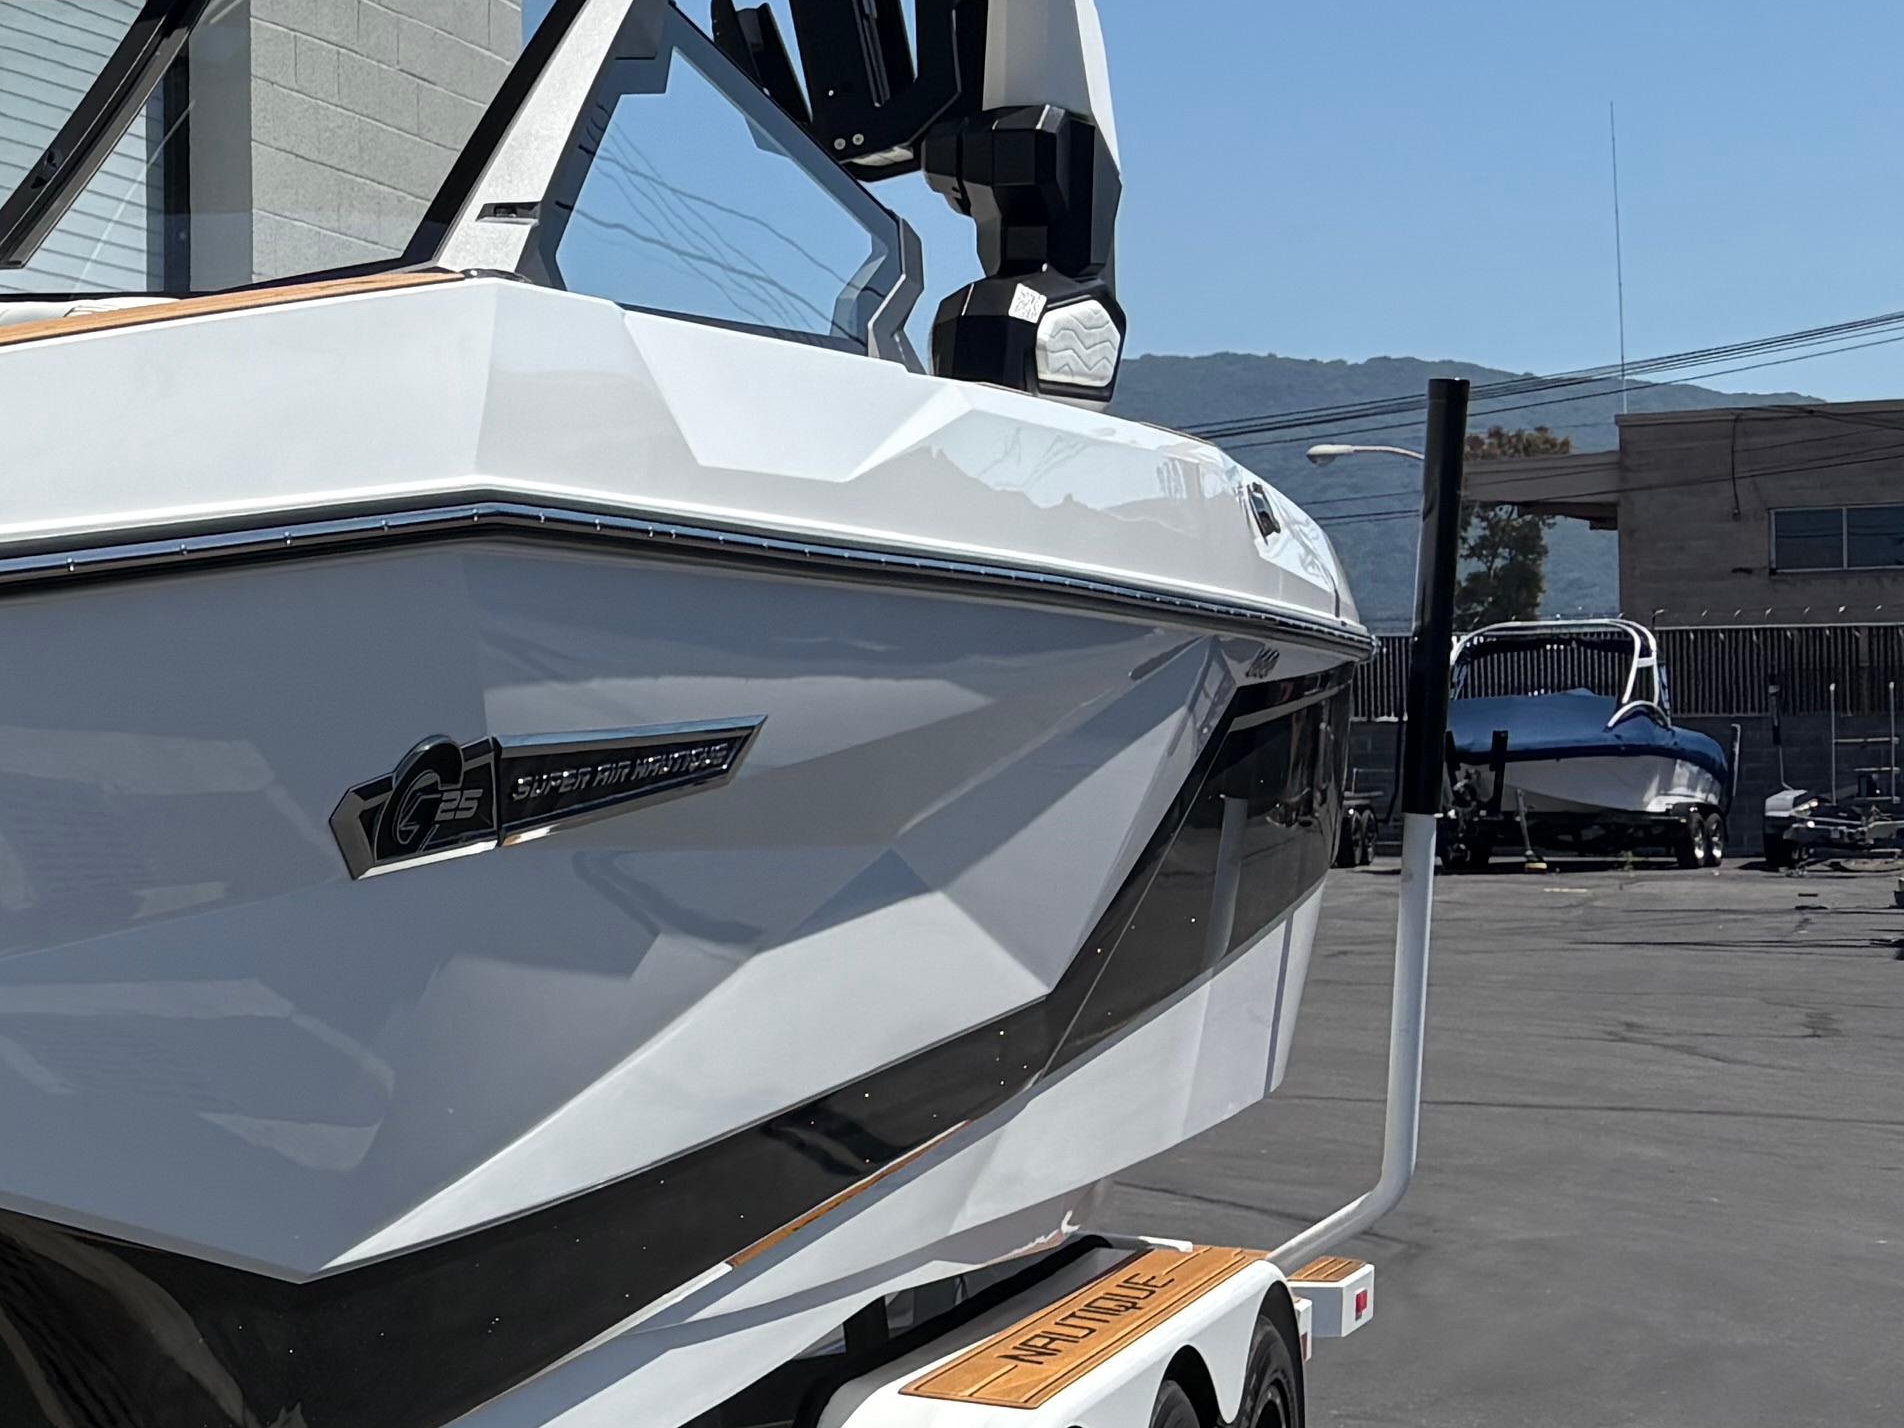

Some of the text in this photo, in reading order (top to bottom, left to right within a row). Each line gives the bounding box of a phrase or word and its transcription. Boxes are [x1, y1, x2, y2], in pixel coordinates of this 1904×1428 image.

[512, 743, 729, 802] SUPER AIR NAUTIQUE
[998, 1272, 1175, 1365] NAUTIQUE
